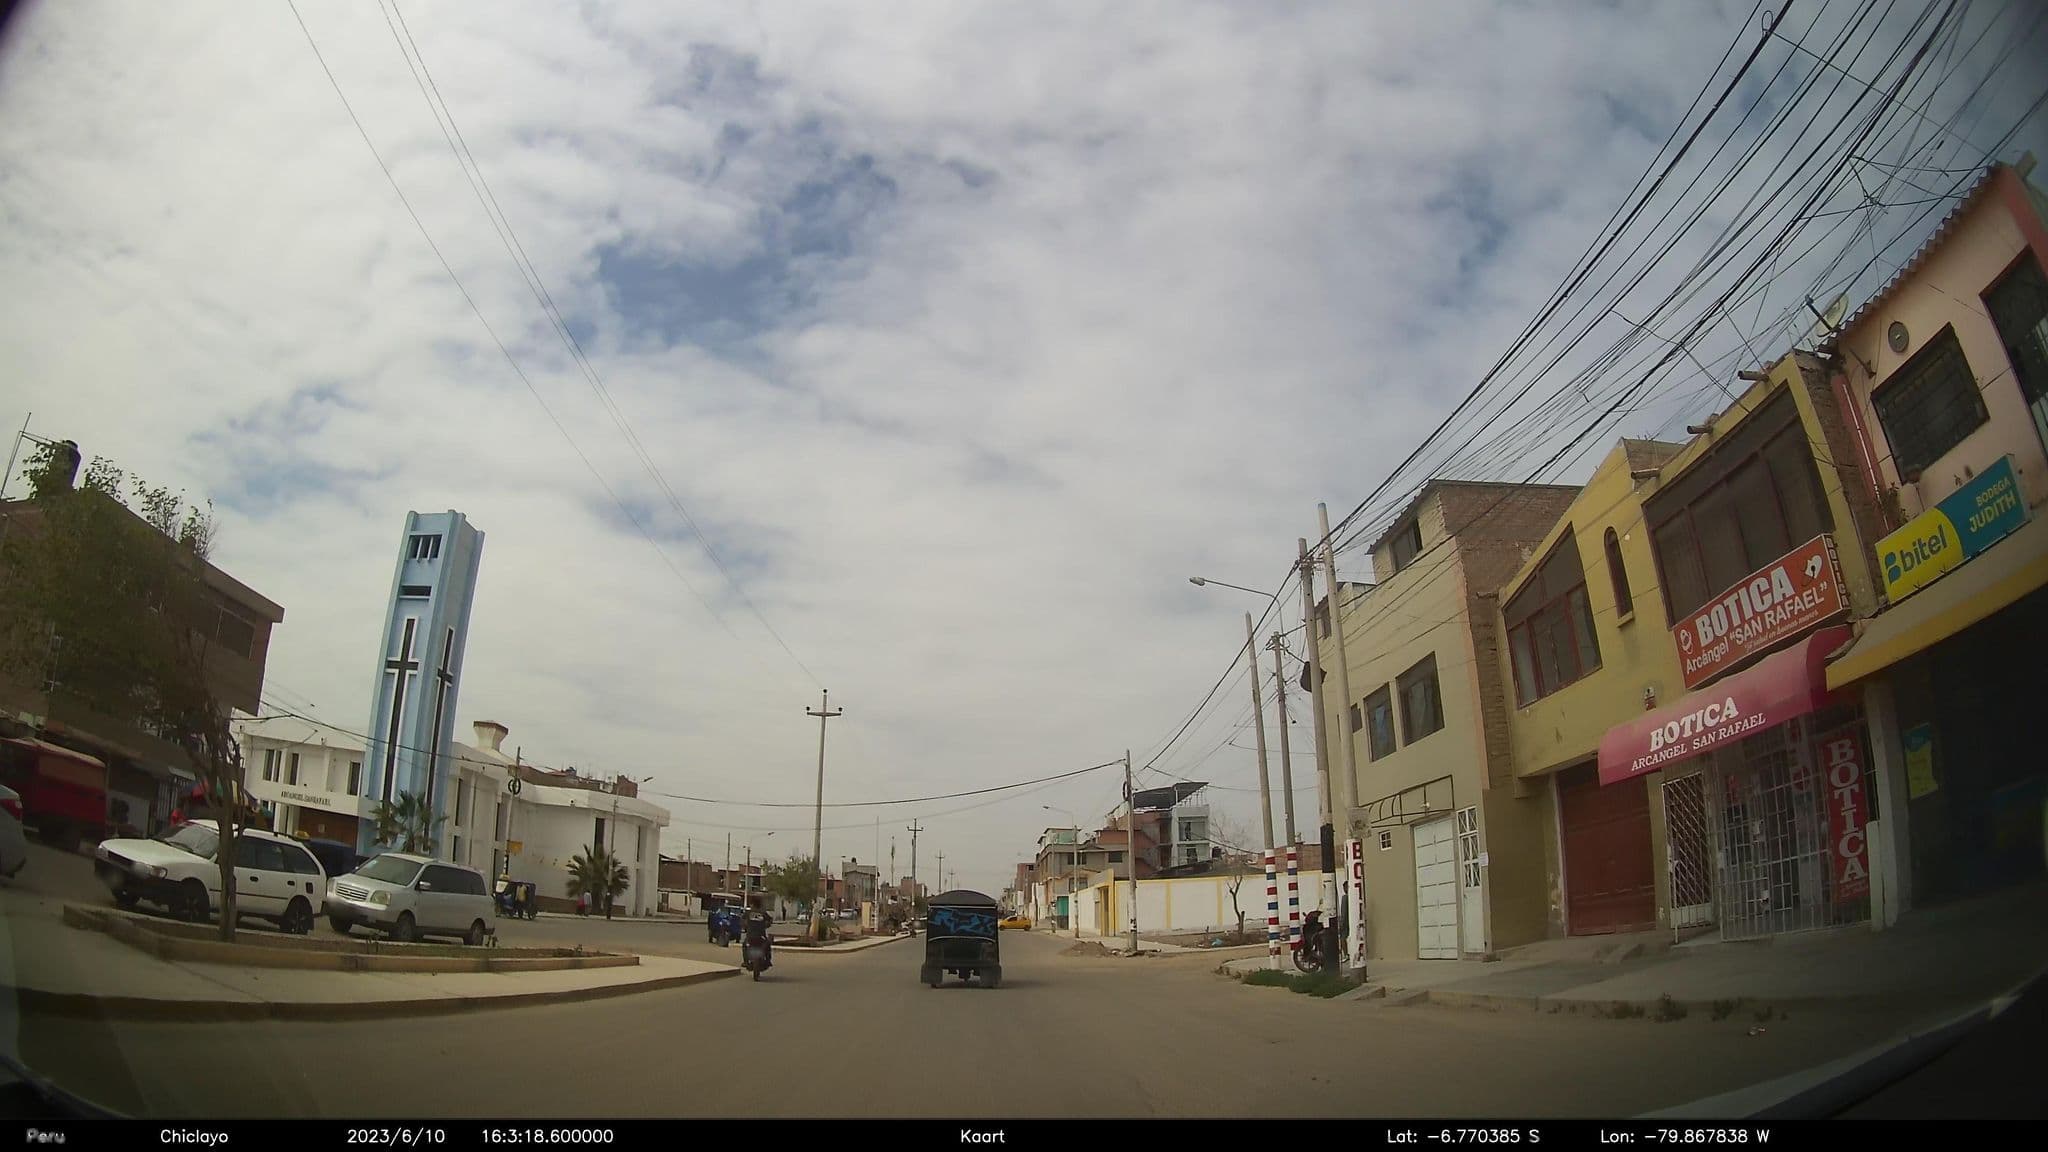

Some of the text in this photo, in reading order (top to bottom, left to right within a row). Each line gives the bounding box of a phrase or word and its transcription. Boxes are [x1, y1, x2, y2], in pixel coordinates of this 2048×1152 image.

[1969, 490, 2017, 533] JUDITH
[1975, 477, 2012, 506] BODEGA
[1825, 537, 1850, 606] BOTICA
[1900, 524, 1948, 572] bitel
[1695, 565, 1796, 648] BOTICA
[1686, 636, 1730, 674] Arcángel
[1631, 712, 1766, 771] ARCANGEL SAN RAFAEL
[1649, 696, 1739, 753] BOTICA
[1826, 738, 1868, 885] BOTICA
